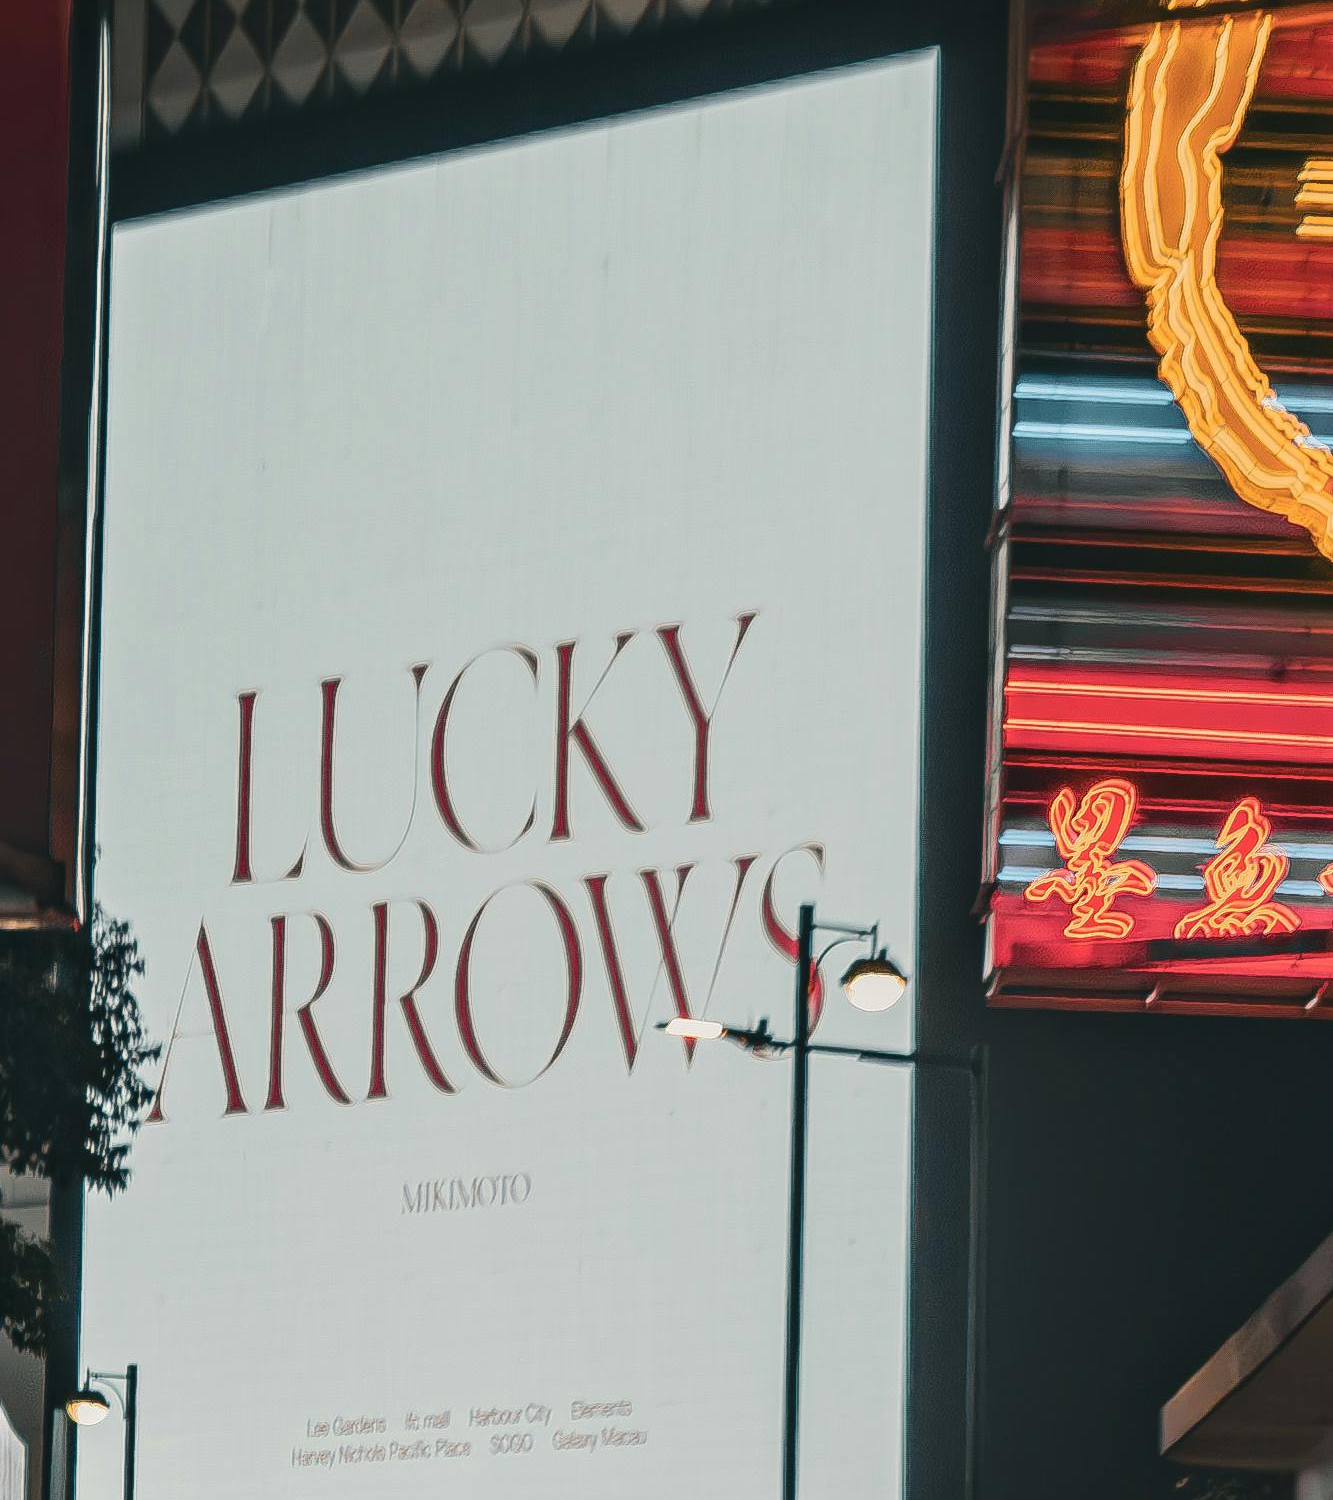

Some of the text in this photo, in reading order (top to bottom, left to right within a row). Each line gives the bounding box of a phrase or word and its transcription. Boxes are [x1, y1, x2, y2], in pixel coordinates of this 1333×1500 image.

[230, 610, 758, 887] LUCKY
[145, 841, 828, 1124] ARROWS
[401, 1171, 532, 1215] MIKIMOTO
[306, 1417, 330, 1438] Lee
[332, 1414, 387, 1438] Gardens
[469, 1406, 523, 1429] Harbour
[525, 1403, 553, 1427] City
[291, 1446, 336, 1470] Harvey
[489, 1434, 533, 1456] SOGO
